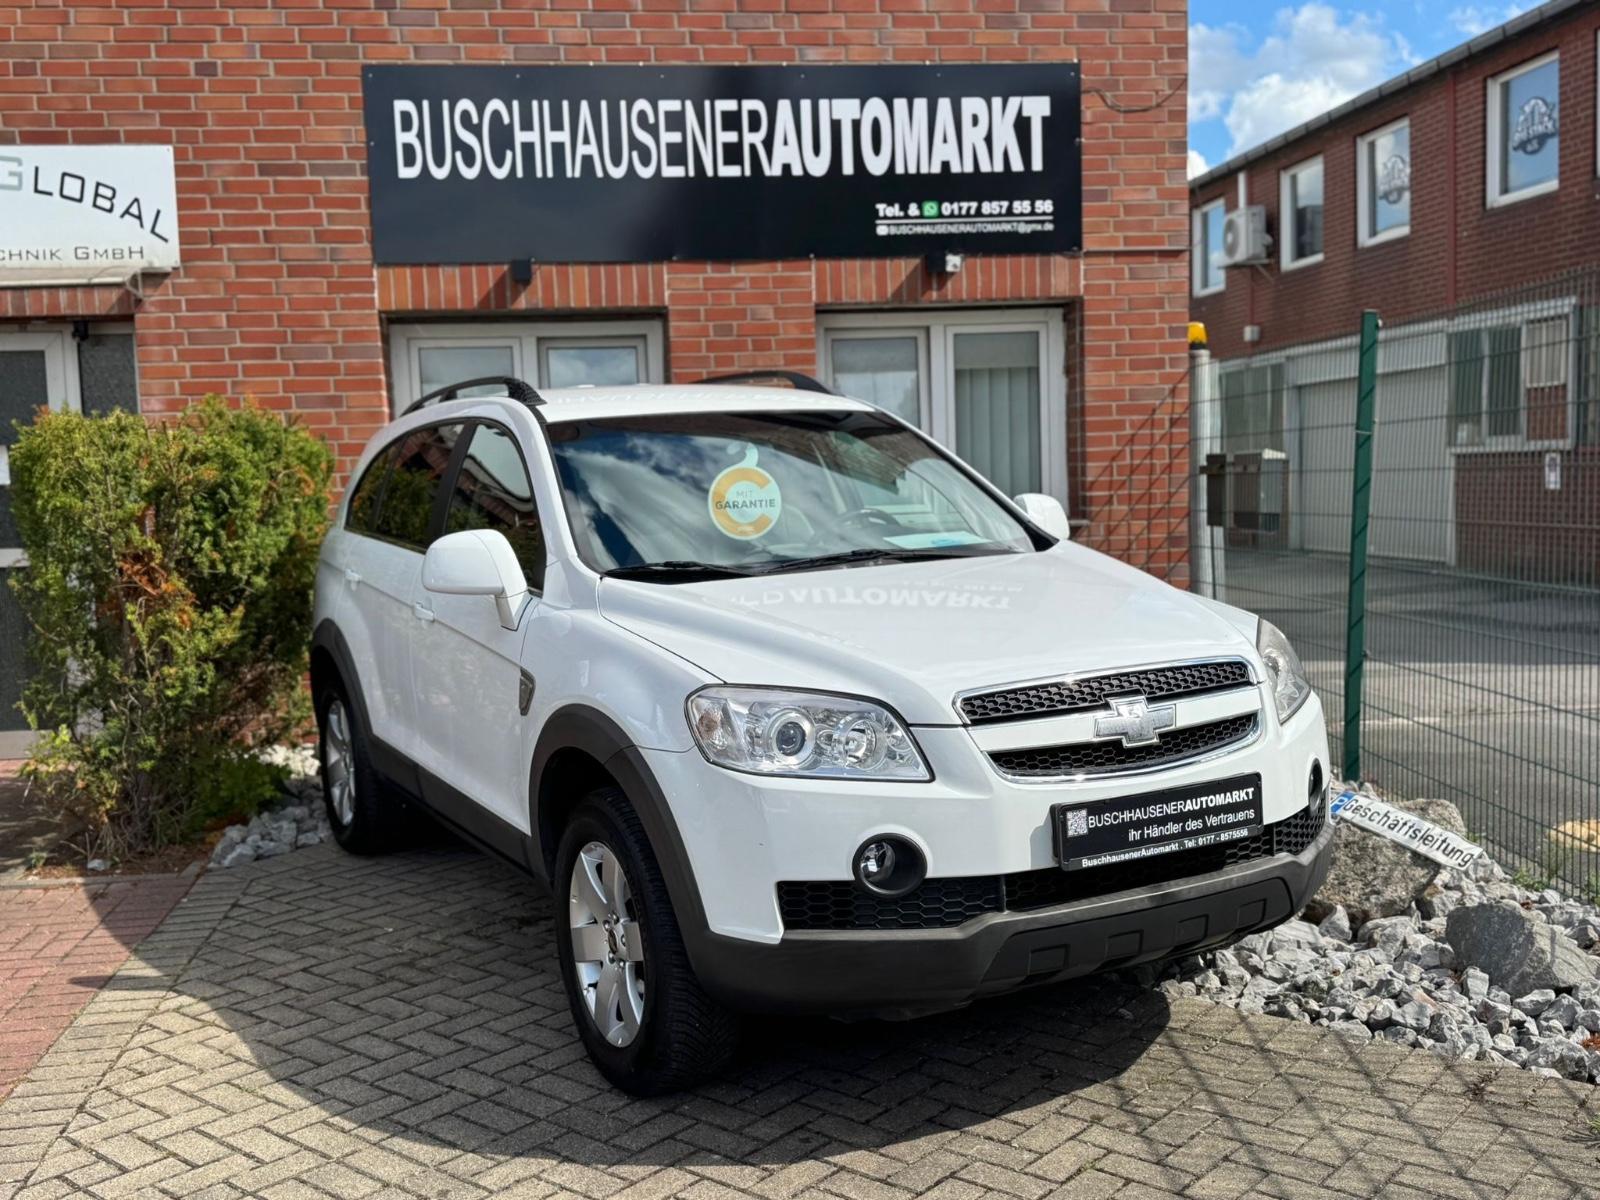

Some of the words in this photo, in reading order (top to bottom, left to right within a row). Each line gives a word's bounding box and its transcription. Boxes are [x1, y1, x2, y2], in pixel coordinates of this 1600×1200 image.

[393, 95, 1051, 180] BUSCHHAUSENERAUTOMARKT
[0, 154, 169, 243] GLOBAL
[875, 203, 904, 217] Tel.
[907, 203, 920, 216] &
[941, 201, 978, 216] 0177
[981, 200, 1009, 215] 857
[1012, 200, 1031, 214] 55
[1034, 199, 1054, 213] 56
[715, 499, 776, 510] GARANTIE
[1088, 788, 1254, 828] BUSCHHAUSENERAUTOMARKT
[1144, 822, 1183, 839] Händler
[1185, 818, 1203, 831] des
[1205, 809, 1255, 827] Vertrauens
[1082, 842, 1179, 868] BuschhausenerAutomarkt
[1198, 835, 1215, 846] 0177
